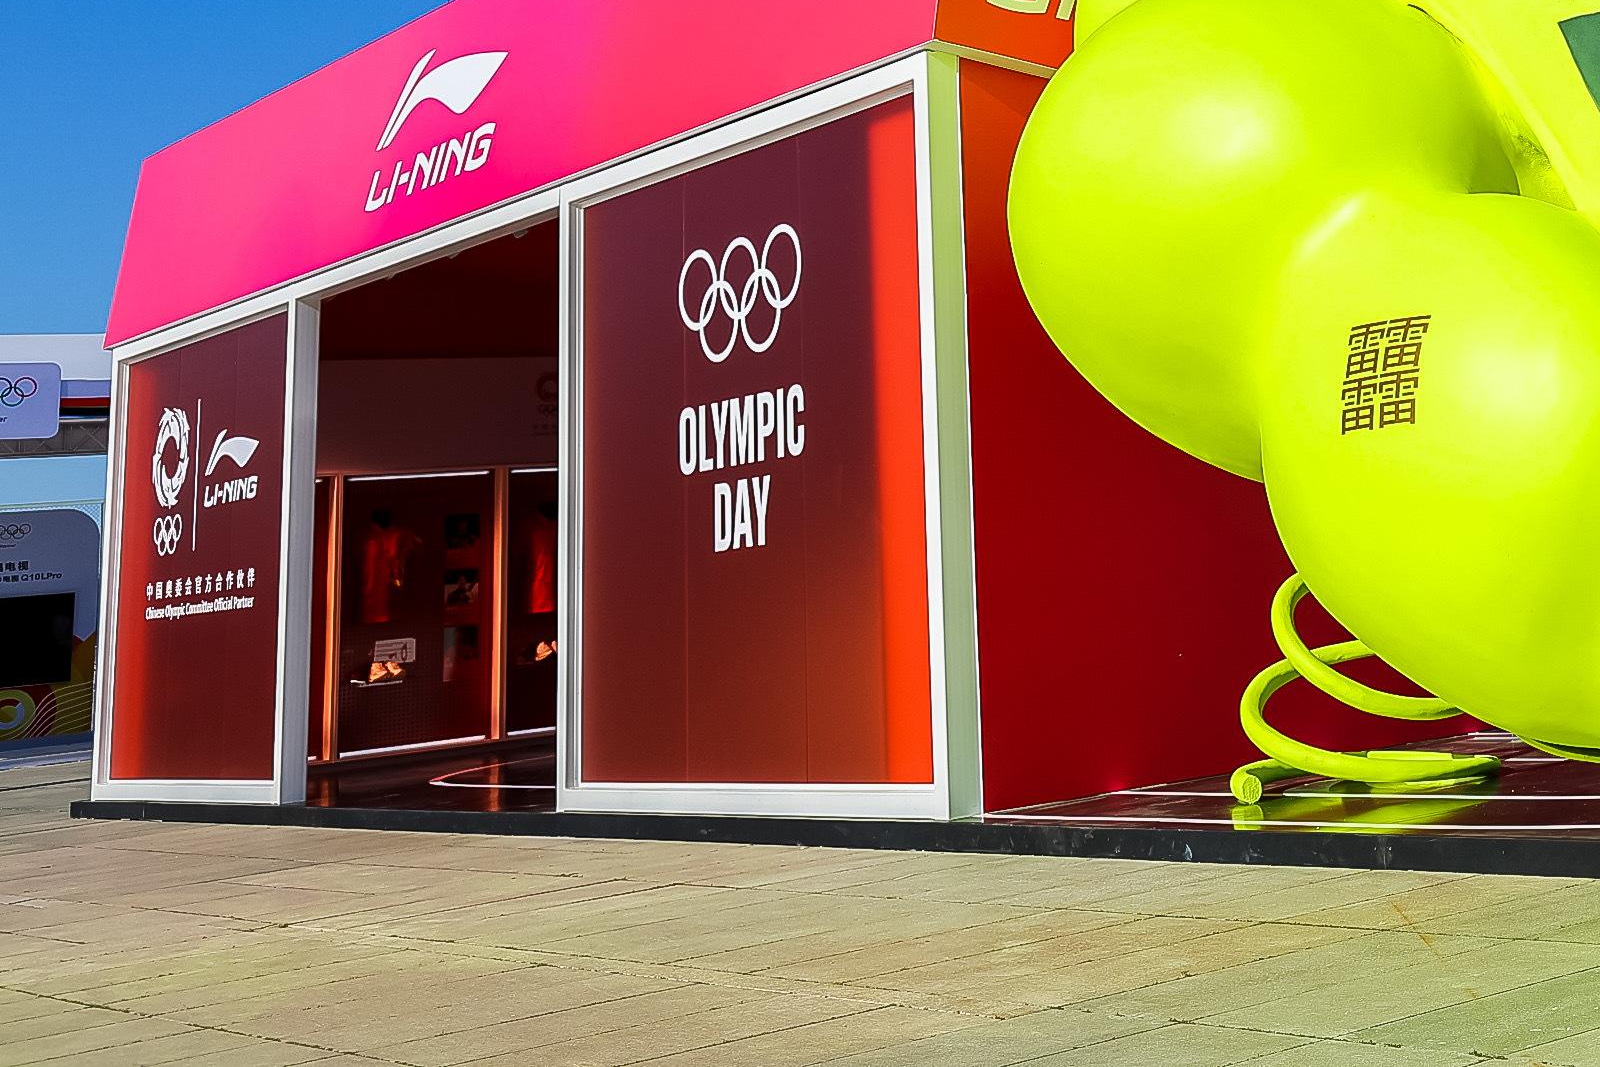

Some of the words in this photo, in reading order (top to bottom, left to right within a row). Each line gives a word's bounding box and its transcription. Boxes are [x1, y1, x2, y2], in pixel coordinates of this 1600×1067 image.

[364, 122, 497, 212] LI-NING
[679, 384, 805, 476] OLYMPIC
[204, 475, 259, 508] LI-NING
[714, 474, 771, 553] DAY
[146, 568, 256, 602] 中国奥委会官方合作伙伴
[233, 595, 255, 610] Partner
